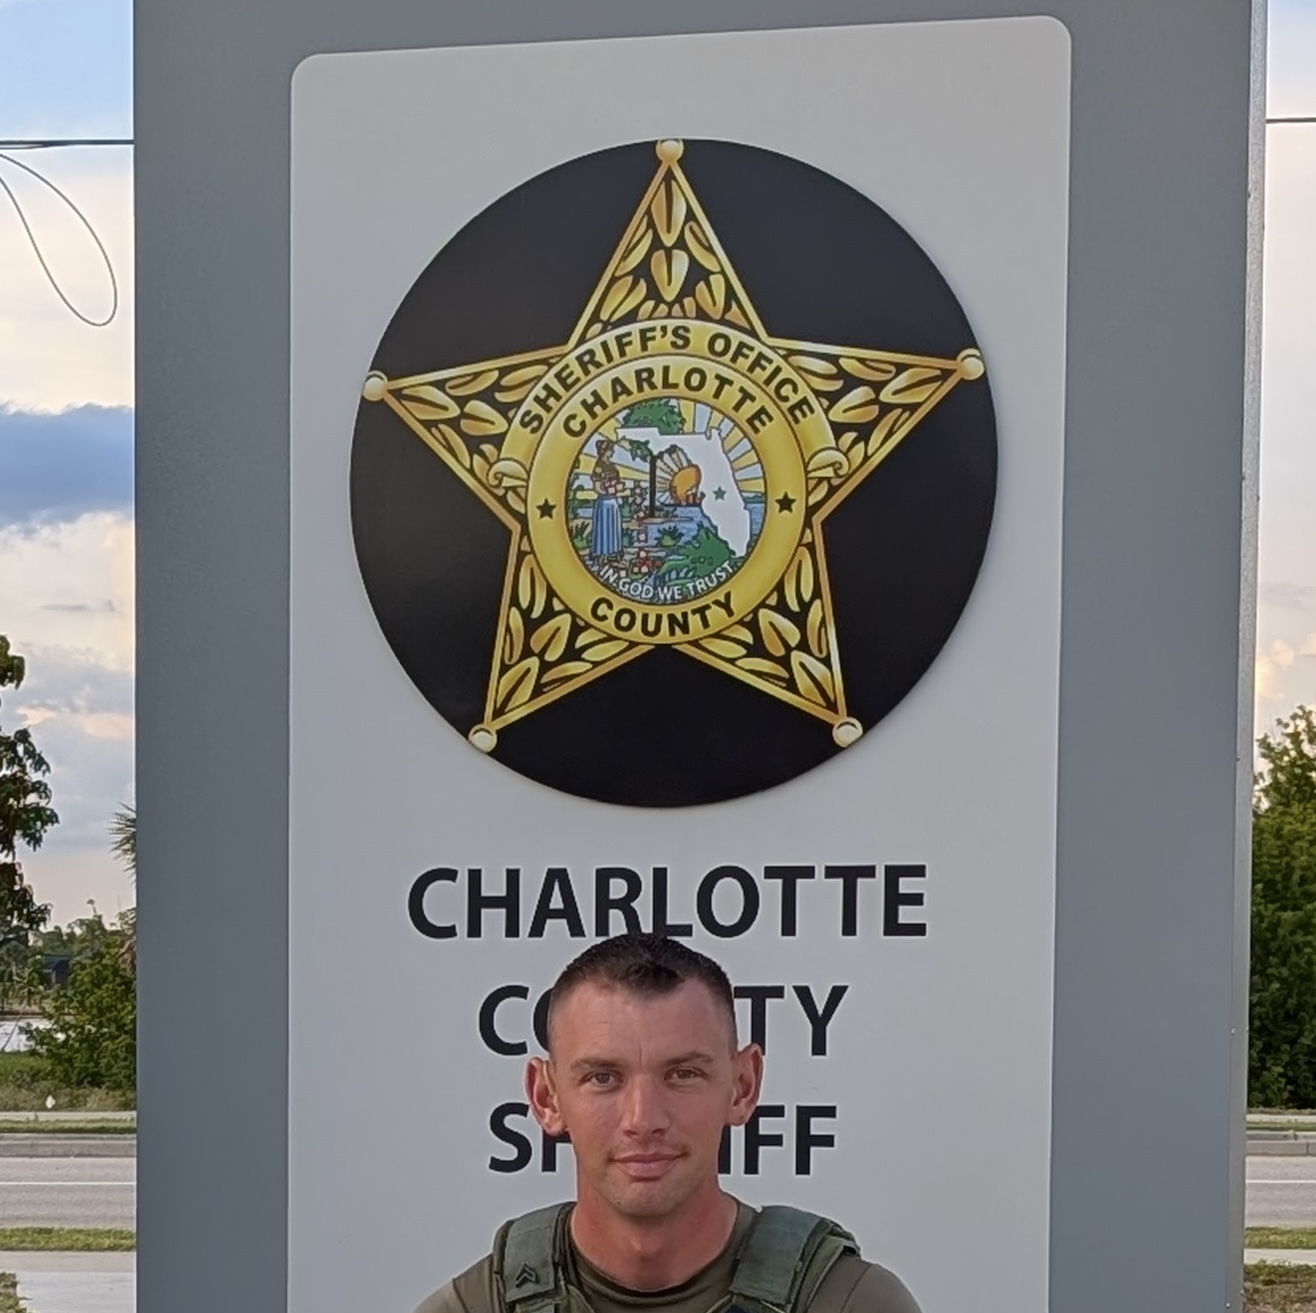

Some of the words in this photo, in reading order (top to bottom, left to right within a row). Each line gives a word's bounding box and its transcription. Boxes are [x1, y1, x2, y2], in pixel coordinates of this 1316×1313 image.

[562, 364, 775, 438] CHARLOTTE
[707, 332, 816, 425] OFFICE
[590, 591, 736, 638] COUNTY
[619, 577, 654, 599] GOD
[658, 585, 683, 600] WE
[686, 559, 734, 596] TRUST
[407, 864, 928, 939] CHARLOTTE
[478, 984, 849, 1057] CTY
